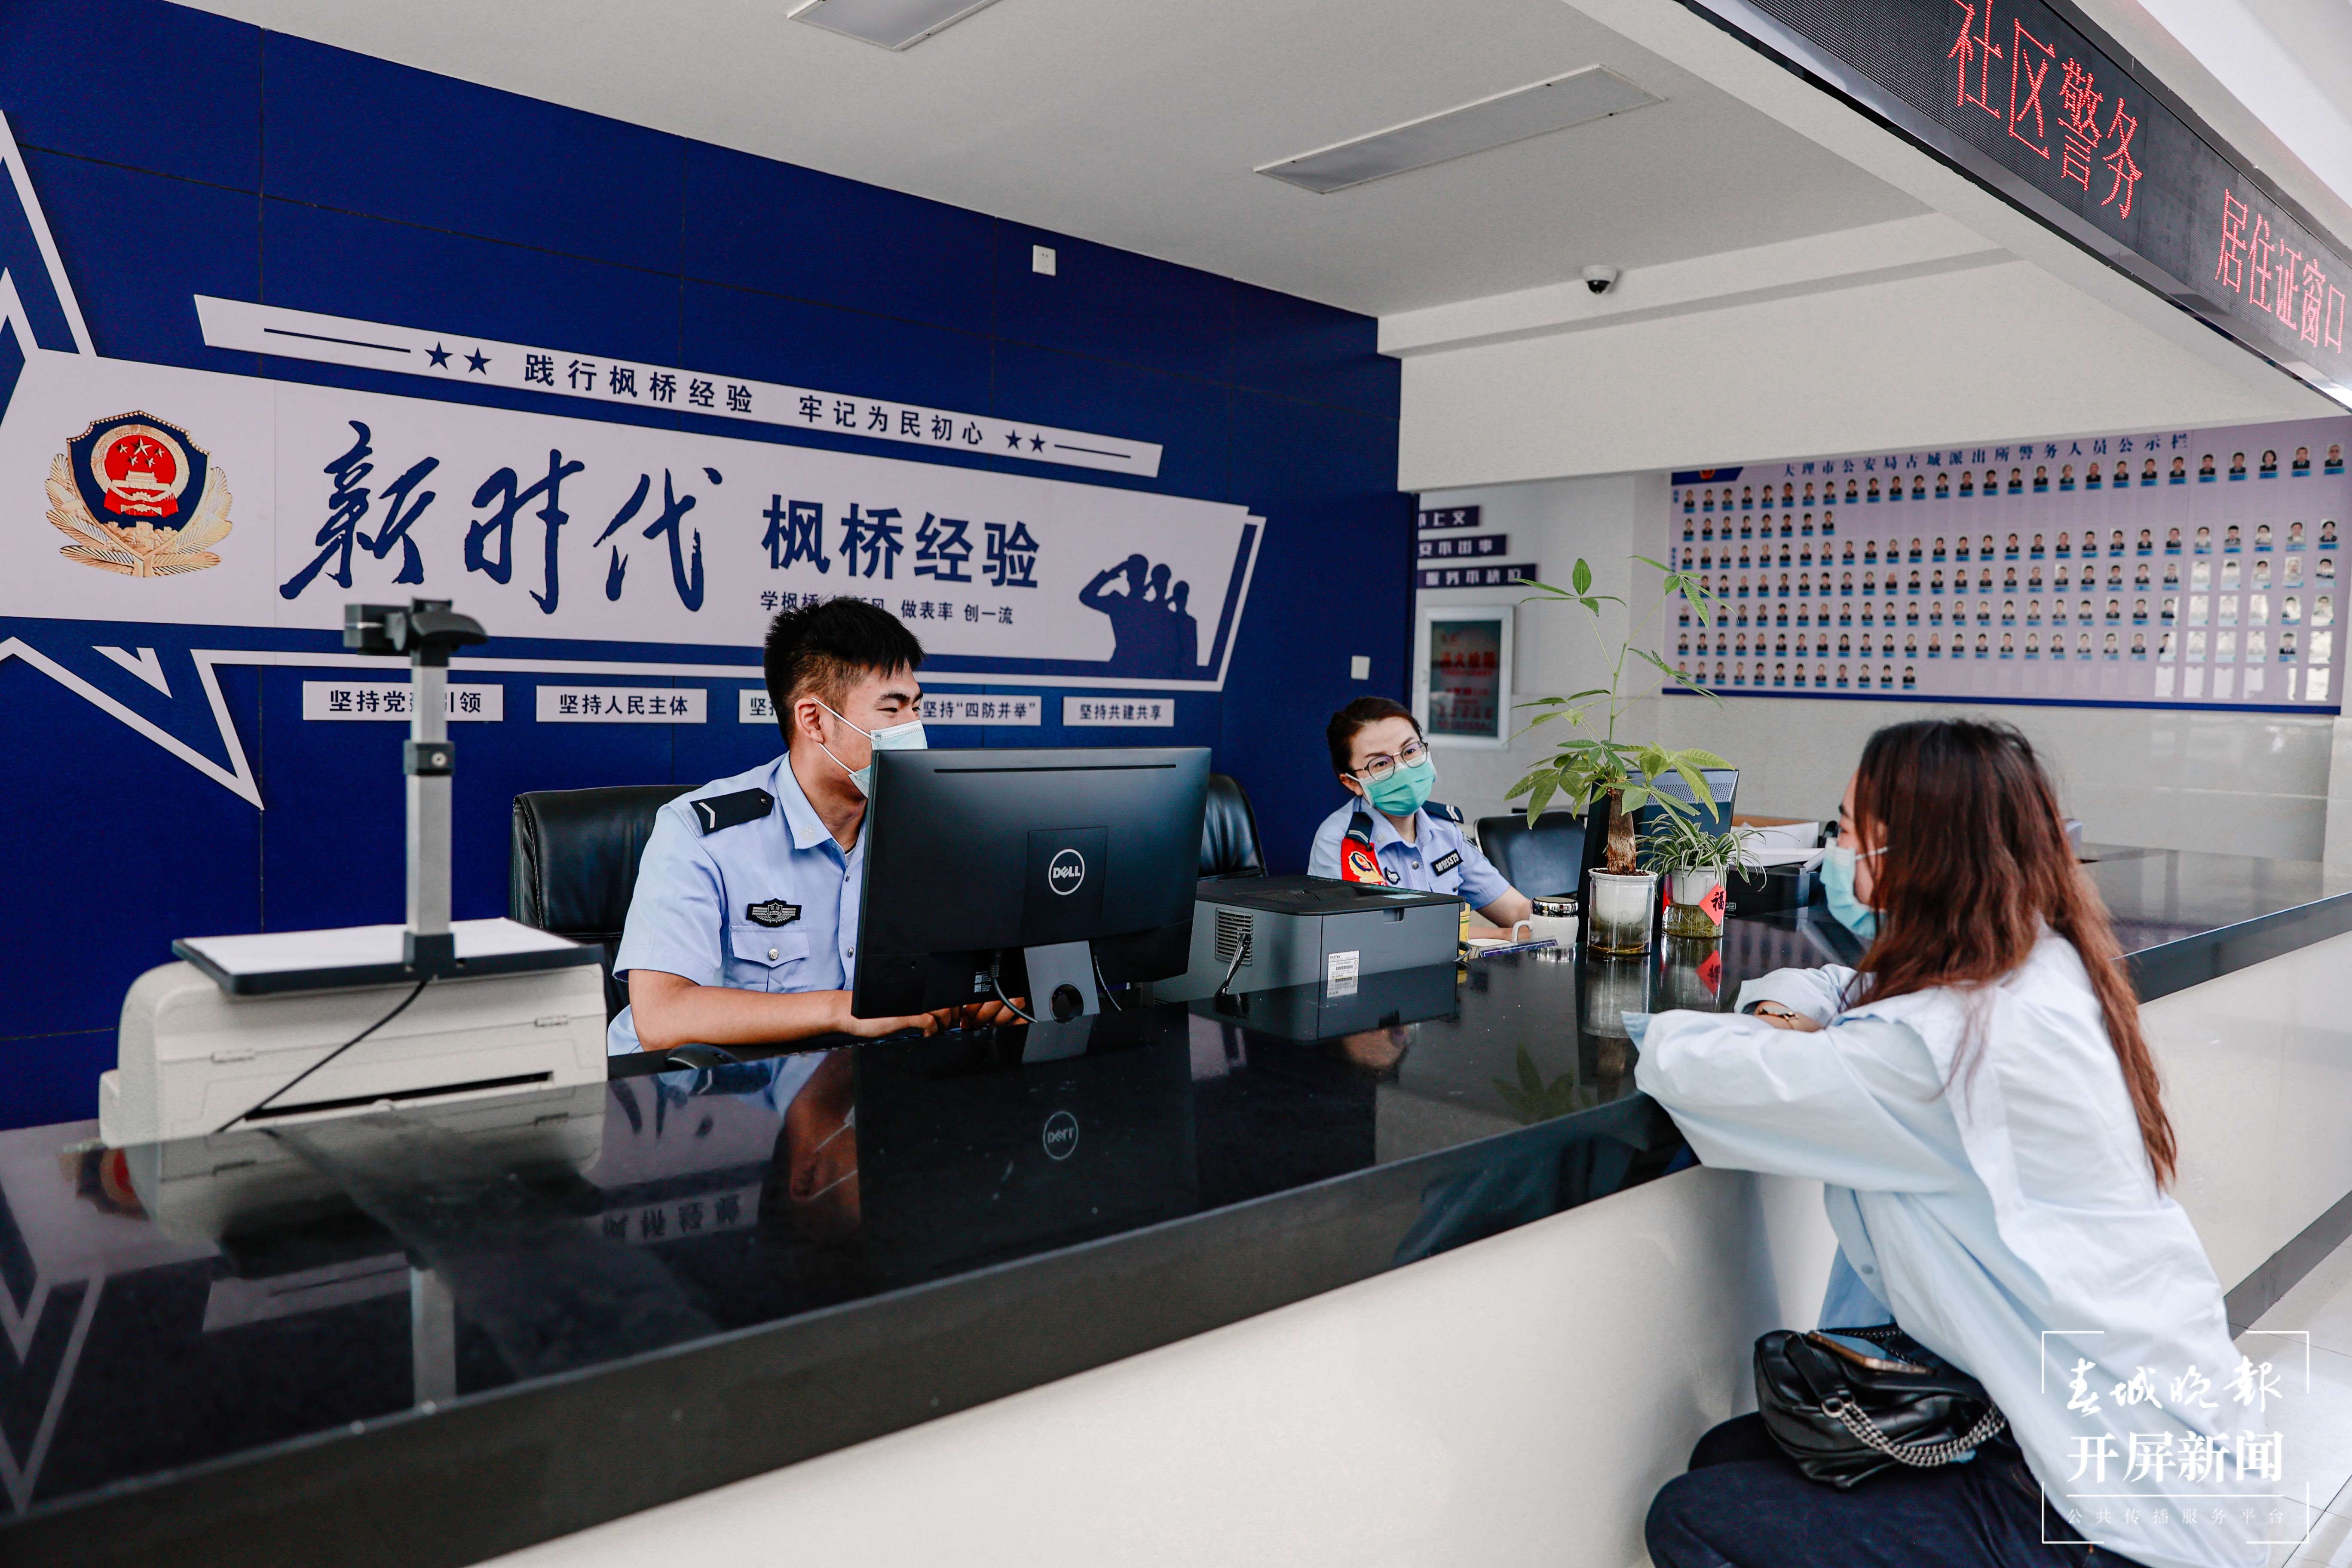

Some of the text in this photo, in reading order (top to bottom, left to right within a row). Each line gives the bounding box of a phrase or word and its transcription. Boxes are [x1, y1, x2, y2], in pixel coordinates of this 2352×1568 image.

[1948, 0, 2345, 353] 社区警务 居住证窗口
[524, 353, 983, 445] 践行枫桥经验 牢记为民初心
[279, 420, 1040, 615] 新时代 枫桥经验
[901, 599, 953, 620] 做表率
[964, 603, 1013, 625] 创一流
[329, 690, 481, 713] 坚持党领
[559, 694, 688, 715] 坚持人民主体
[1079, 704, 1162, 720] 坚持共建共享
[1053, 865, 1081, 879] DELL
[1711, 891, 1724, 912] 福
